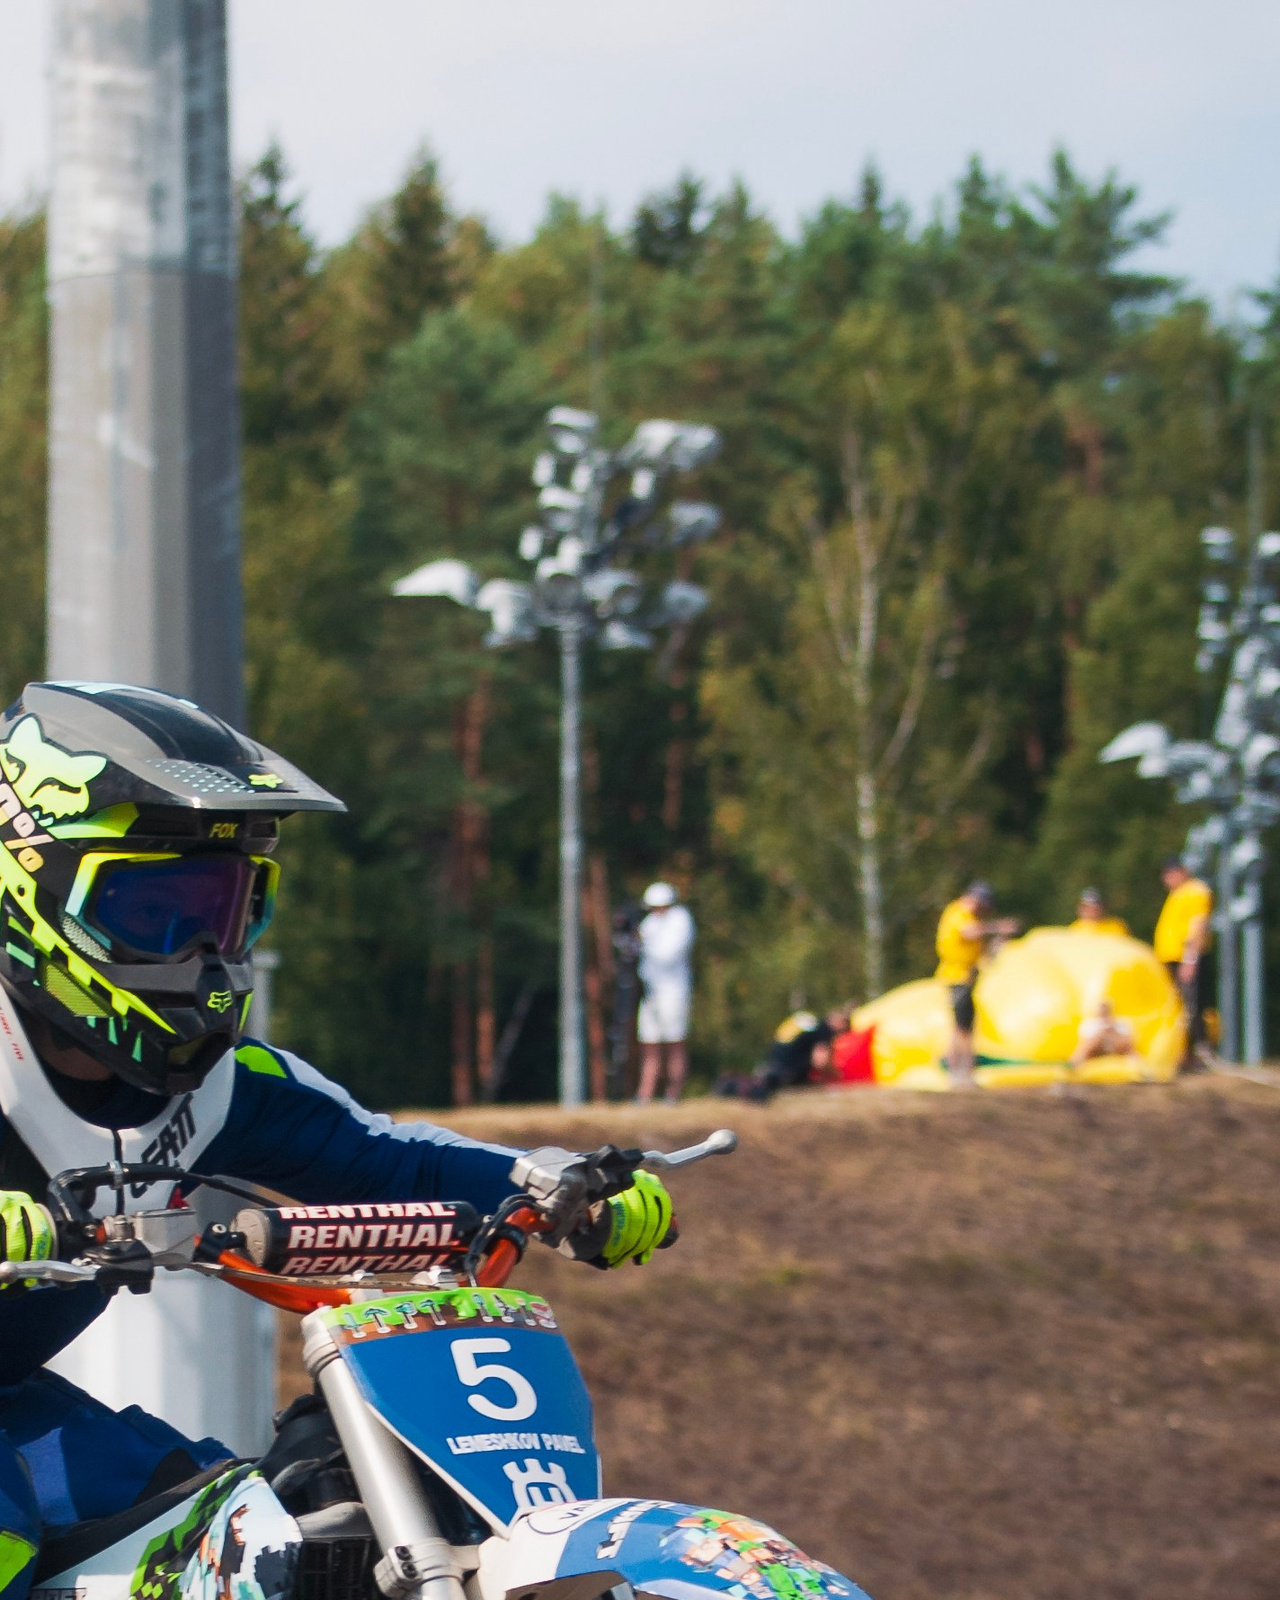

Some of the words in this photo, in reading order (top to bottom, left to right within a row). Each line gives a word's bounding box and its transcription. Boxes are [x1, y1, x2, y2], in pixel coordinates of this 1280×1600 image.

[209, 823, 237, 839] FOX
[277, 1202, 457, 1219] RENTHAL
[287, 1223, 461, 1249] RENTHAL
[278, 1254, 452, 1275] RENTHAL
[449, 1337, 538, 1421] 5
[540, 1433, 587, 1454] PAVEL
